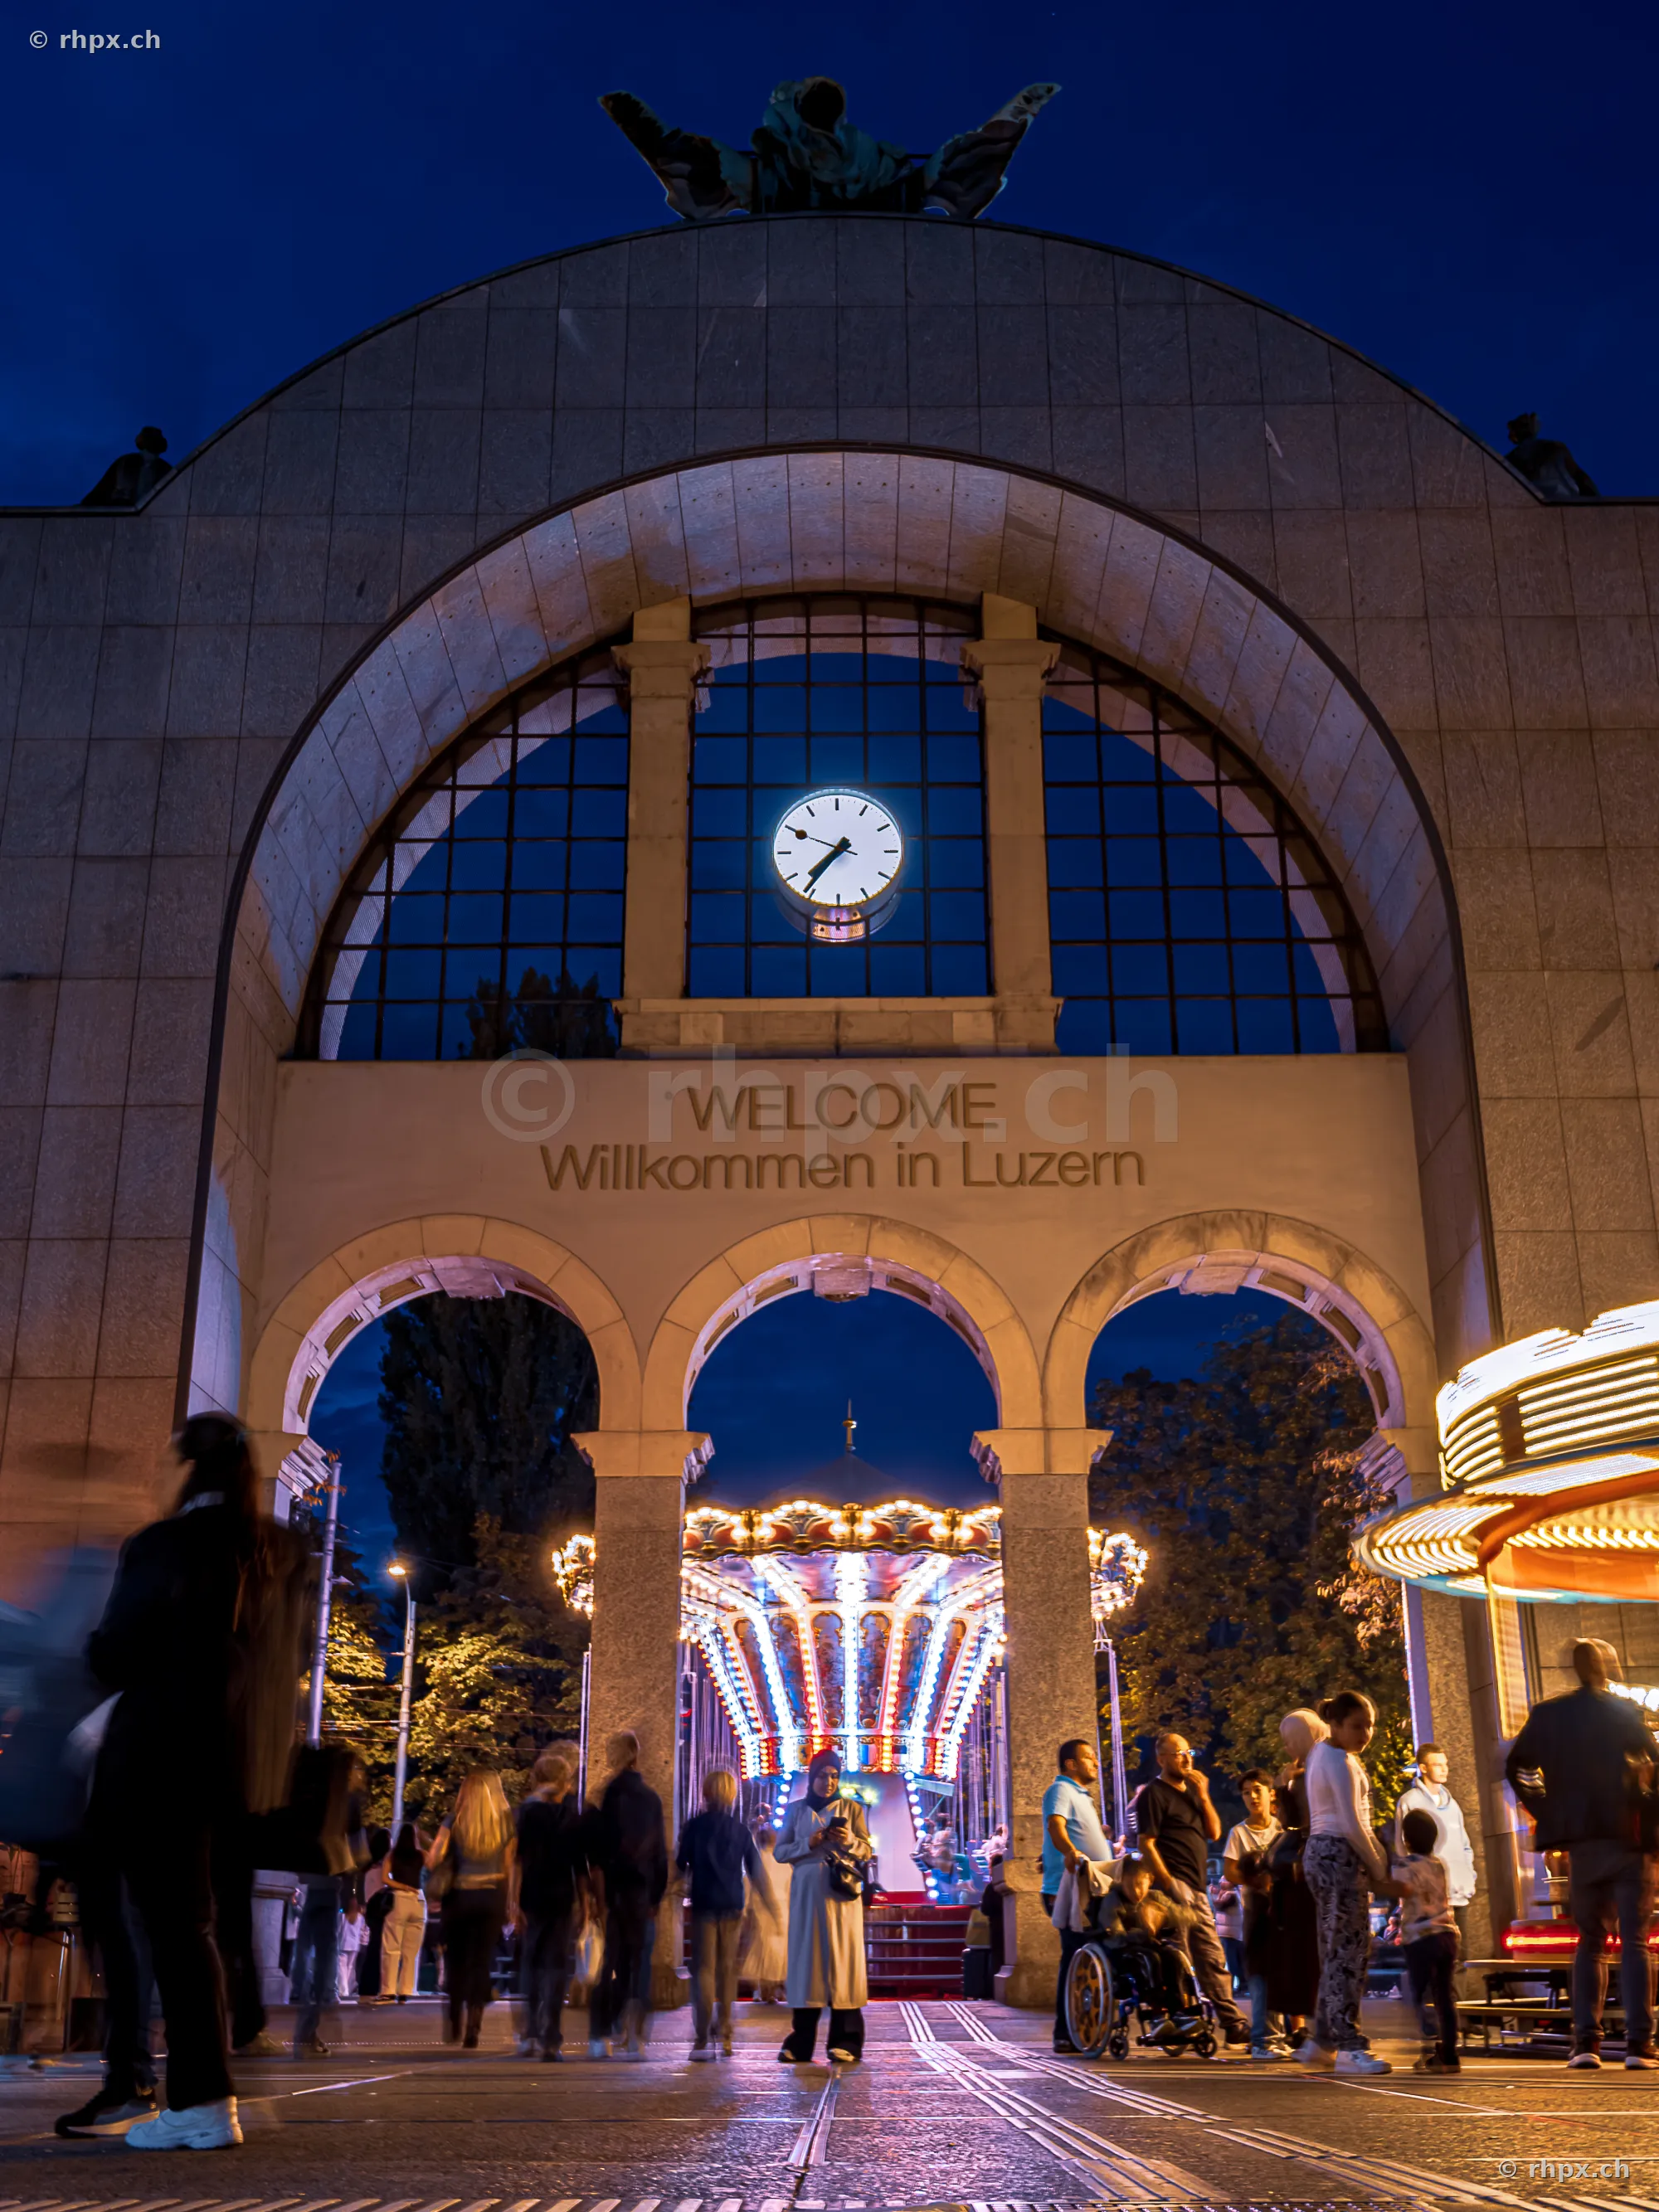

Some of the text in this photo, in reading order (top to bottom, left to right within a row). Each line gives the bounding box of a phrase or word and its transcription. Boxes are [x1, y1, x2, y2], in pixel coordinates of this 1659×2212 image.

[687, 1082, 1000, 1131] WELCOME
[539, 1141, 1146, 1191] Willkommen in Luzern
